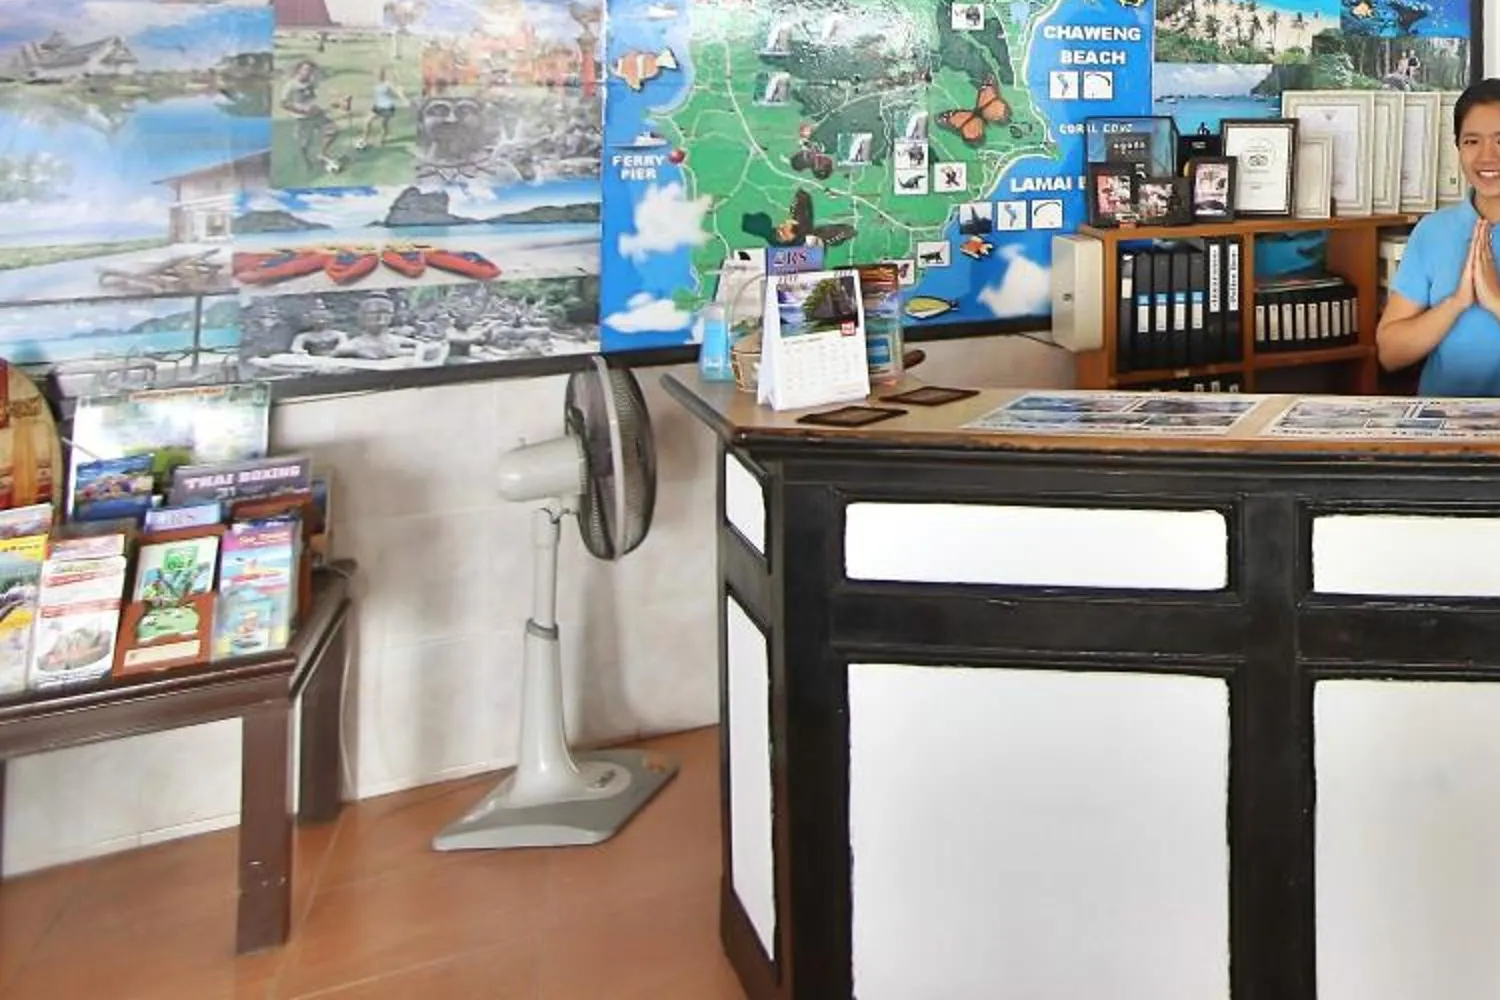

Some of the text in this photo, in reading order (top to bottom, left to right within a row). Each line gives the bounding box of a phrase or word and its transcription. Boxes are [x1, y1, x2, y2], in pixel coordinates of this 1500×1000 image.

[1043, 24, 1142, 43] CHAWENG
[1060, 49, 1127, 66] BEACH
[612, 154, 665, 167] FERRY
[620, 167, 657, 180] PIER
[1010, 175, 1073, 192] LAMAI
[184, 465, 301, 489] THAI BOXING
